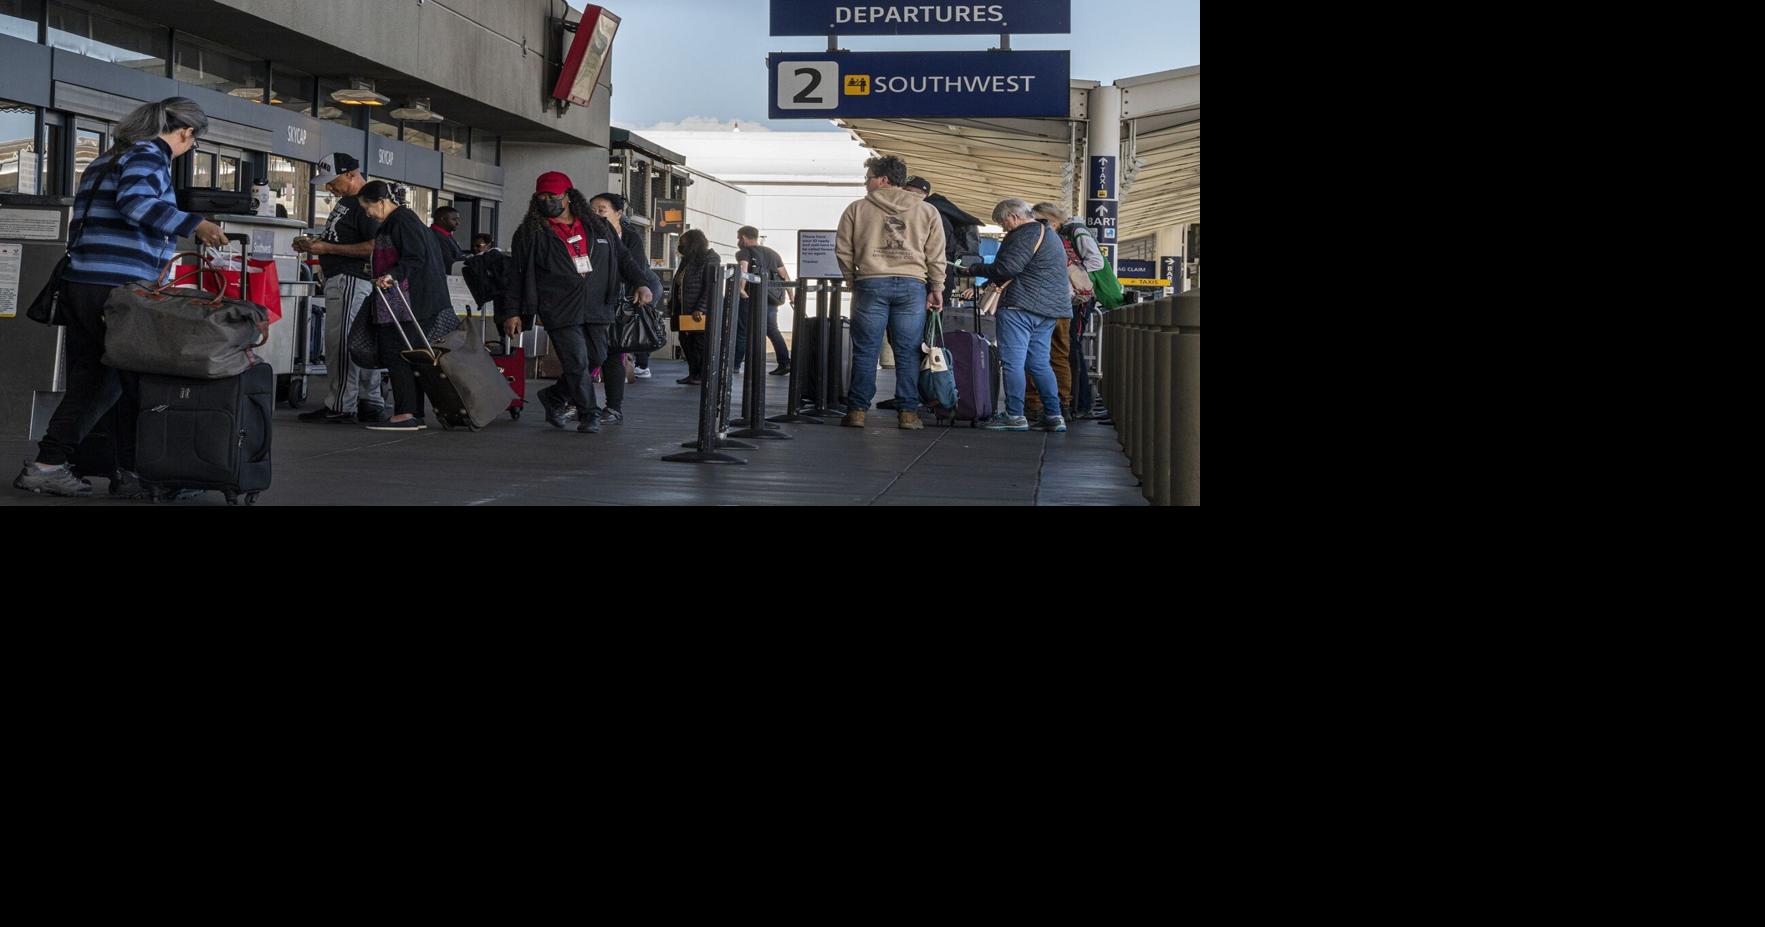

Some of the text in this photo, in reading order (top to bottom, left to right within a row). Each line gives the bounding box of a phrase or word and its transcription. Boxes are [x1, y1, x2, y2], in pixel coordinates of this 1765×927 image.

[835, 5, 1004, 24] DEPARTURES
[792, 67, 1036, 104] 2 SOUTHWEST
[287, 125, 307, 145] SKYCAP
[378, 148, 394, 166] SKYCAP
[1087, 217, 1116, 226] BART
